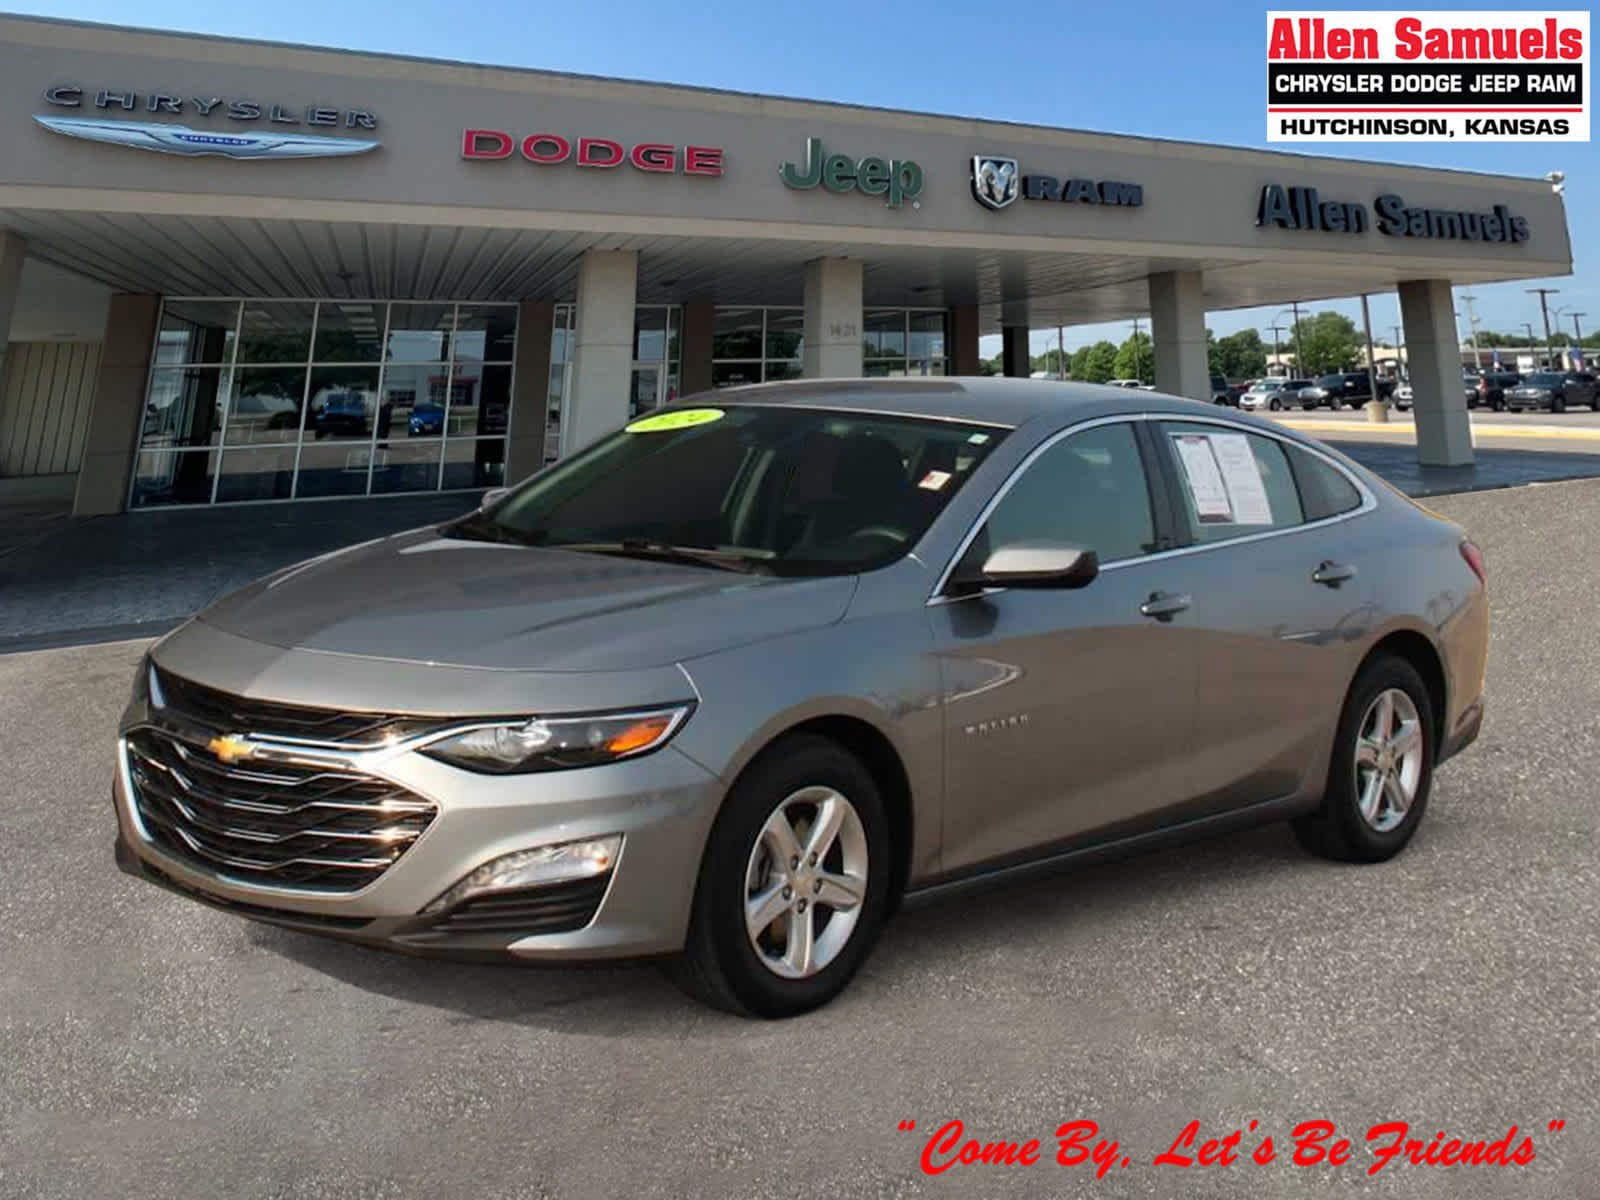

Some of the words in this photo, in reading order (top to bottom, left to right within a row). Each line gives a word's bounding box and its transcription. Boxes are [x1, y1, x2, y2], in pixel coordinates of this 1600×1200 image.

[45, 85, 378, 128] CHRYSLER
[461, 128, 725, 176] DODGE
[779, 137, 923, 208] Jeep
[1023, 175, 1143, 206] RAM
[1257, 184, 1368, 234] Allen
[1376, 194, 1530, 243] Samuels
